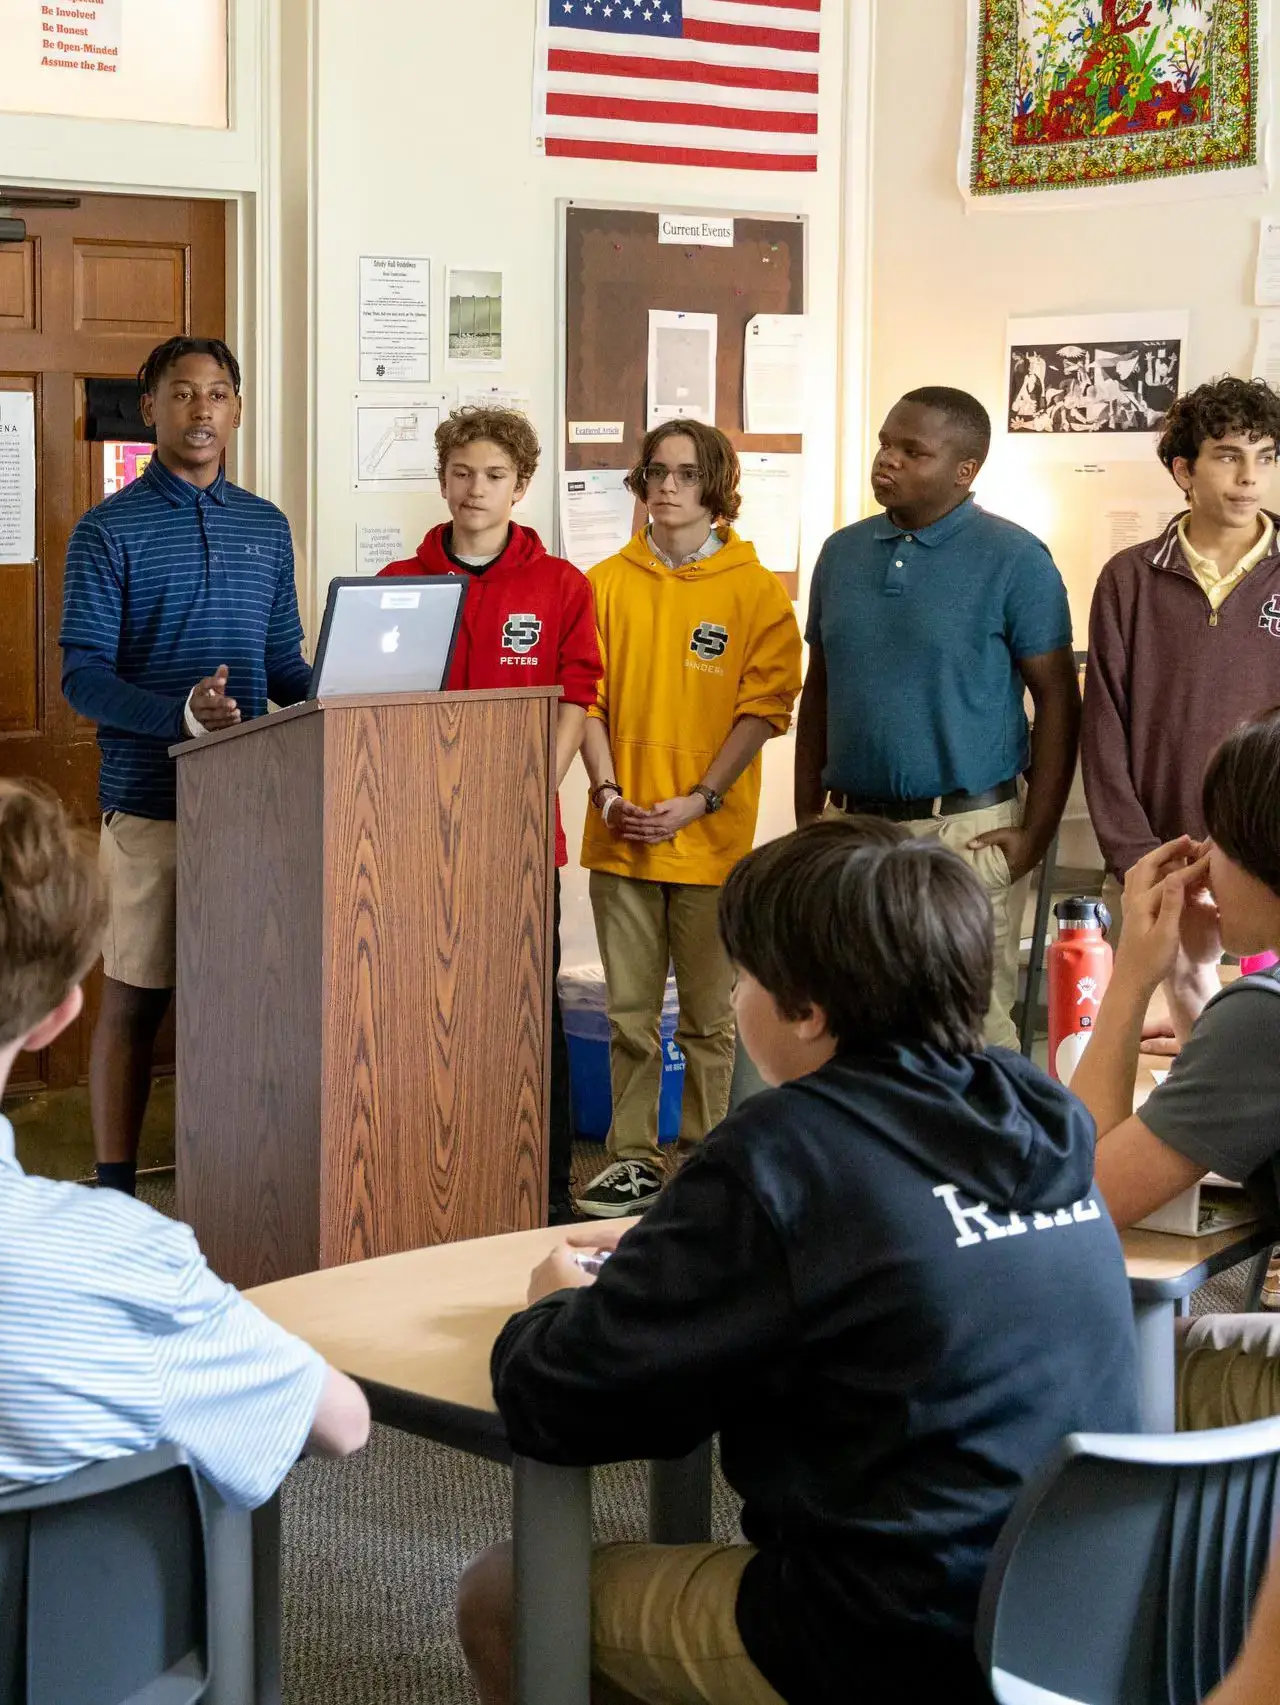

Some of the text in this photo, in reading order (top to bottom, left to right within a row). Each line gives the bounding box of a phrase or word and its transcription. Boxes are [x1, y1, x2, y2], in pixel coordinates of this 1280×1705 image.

[41, 6, 96, 20] Be Involved
[42, 23, 89, 36] Be Honest
[42, 39, 118, 56] Be Open-Minded
[41, 56, 117, 73] Assume the Best
[662, 221, 731, 238] Current Events
[499, 656, 539, 666] PETERS
